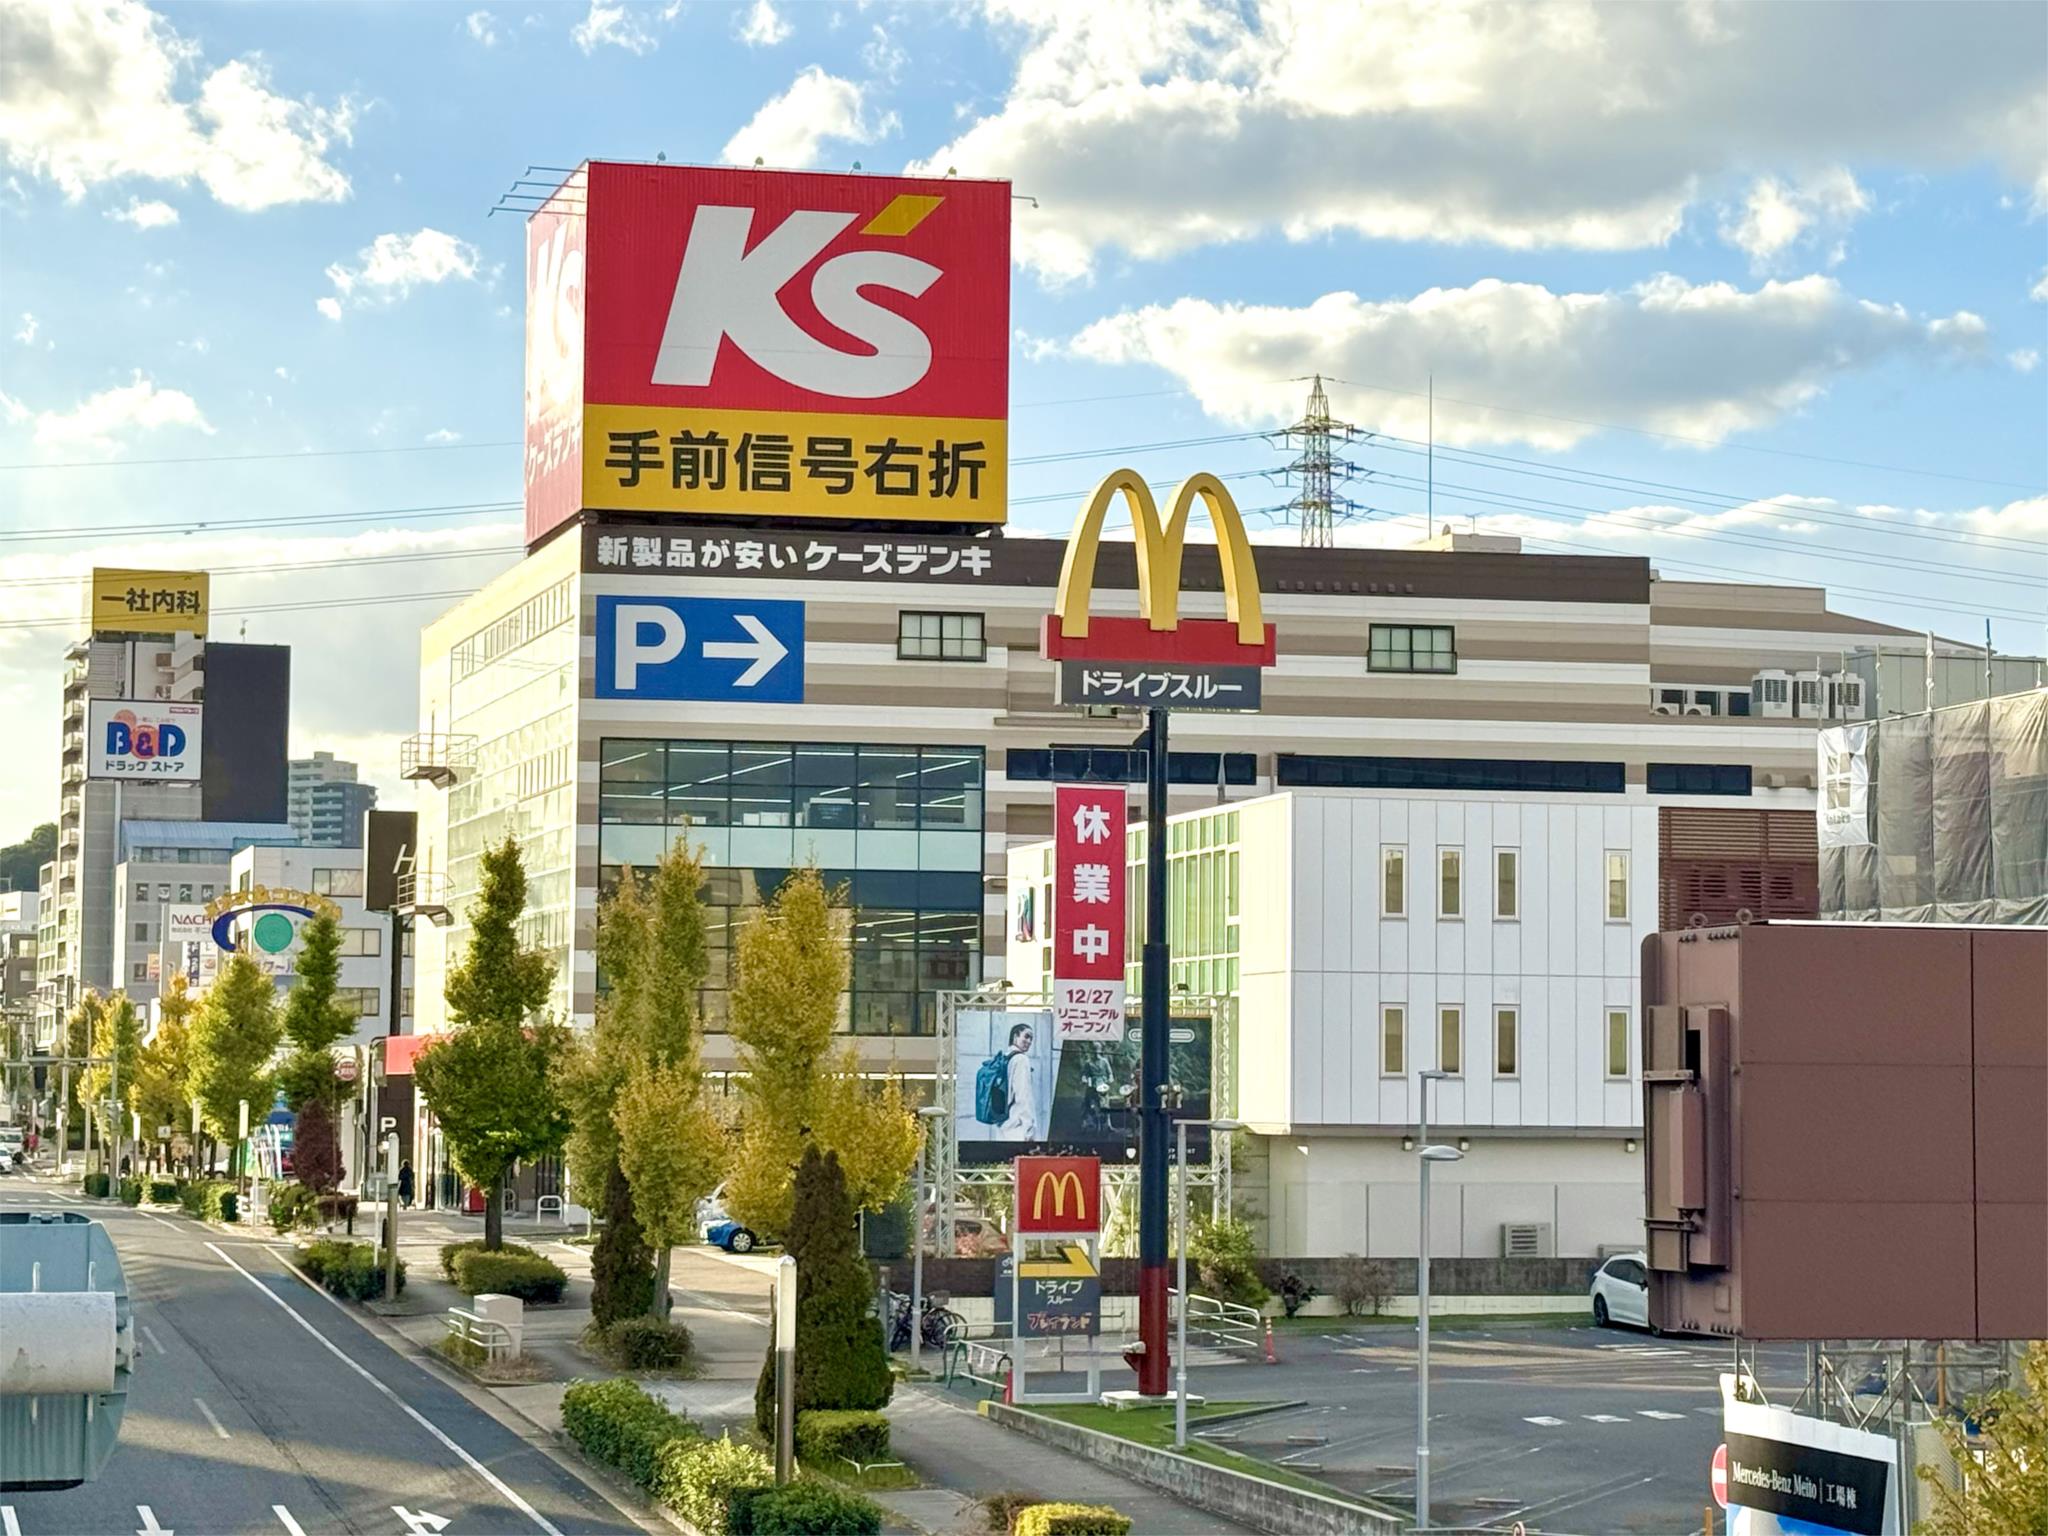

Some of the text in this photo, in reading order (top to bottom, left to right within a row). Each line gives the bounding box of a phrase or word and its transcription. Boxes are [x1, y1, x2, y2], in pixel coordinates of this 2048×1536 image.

[605, 429, 987, 500] 手前信号右折
[101, 588, 201, 614] 一社内科
[615, 604, 687, 690] P
[1081, 670, 1242, 700] ドライブスルー
[106, 722, 186, 757] B&D
[1072, 804, 1111, 965] 休業中
[1066, 989, 1113, 1005] 12/27
[1058, 1008, 1119, 1021] リニューアル
[381, 1117, 397, 1132] P
[1035, 1280, 1084, 1295] ドライブ
[1047, 1296, 1073, 1305] スルー
[1027, 1311, 1092, 1331] プレイランド
[1732, 1461, 1792, 1494] Mercedes-Benz
[1793, 1473, 1818, 1500] Meito
